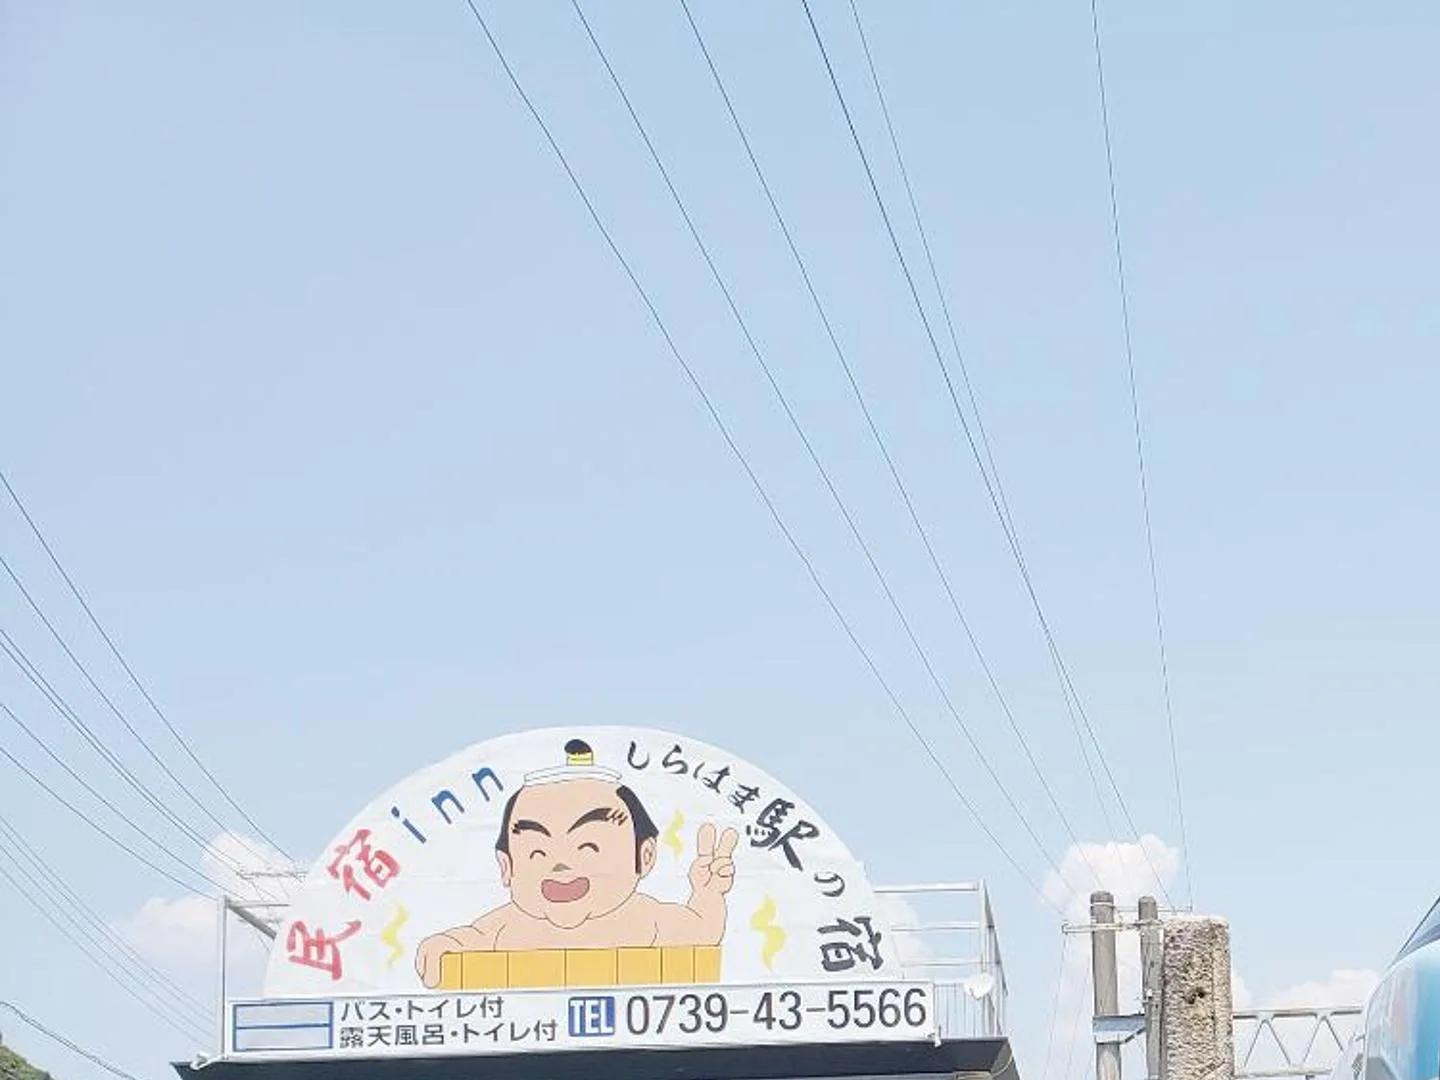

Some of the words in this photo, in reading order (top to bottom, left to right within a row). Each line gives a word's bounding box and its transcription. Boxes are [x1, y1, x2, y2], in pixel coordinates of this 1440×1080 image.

[390, 766, 504, 845] inn
[340, 995, 504, 1022] バス・トイレ付
[570, 999, 615, 1035] TEL
[626, 987, 927, 1036] 0739-43-5566
[339, 1018, 558, 1049] 露天風呂・トイレ付
